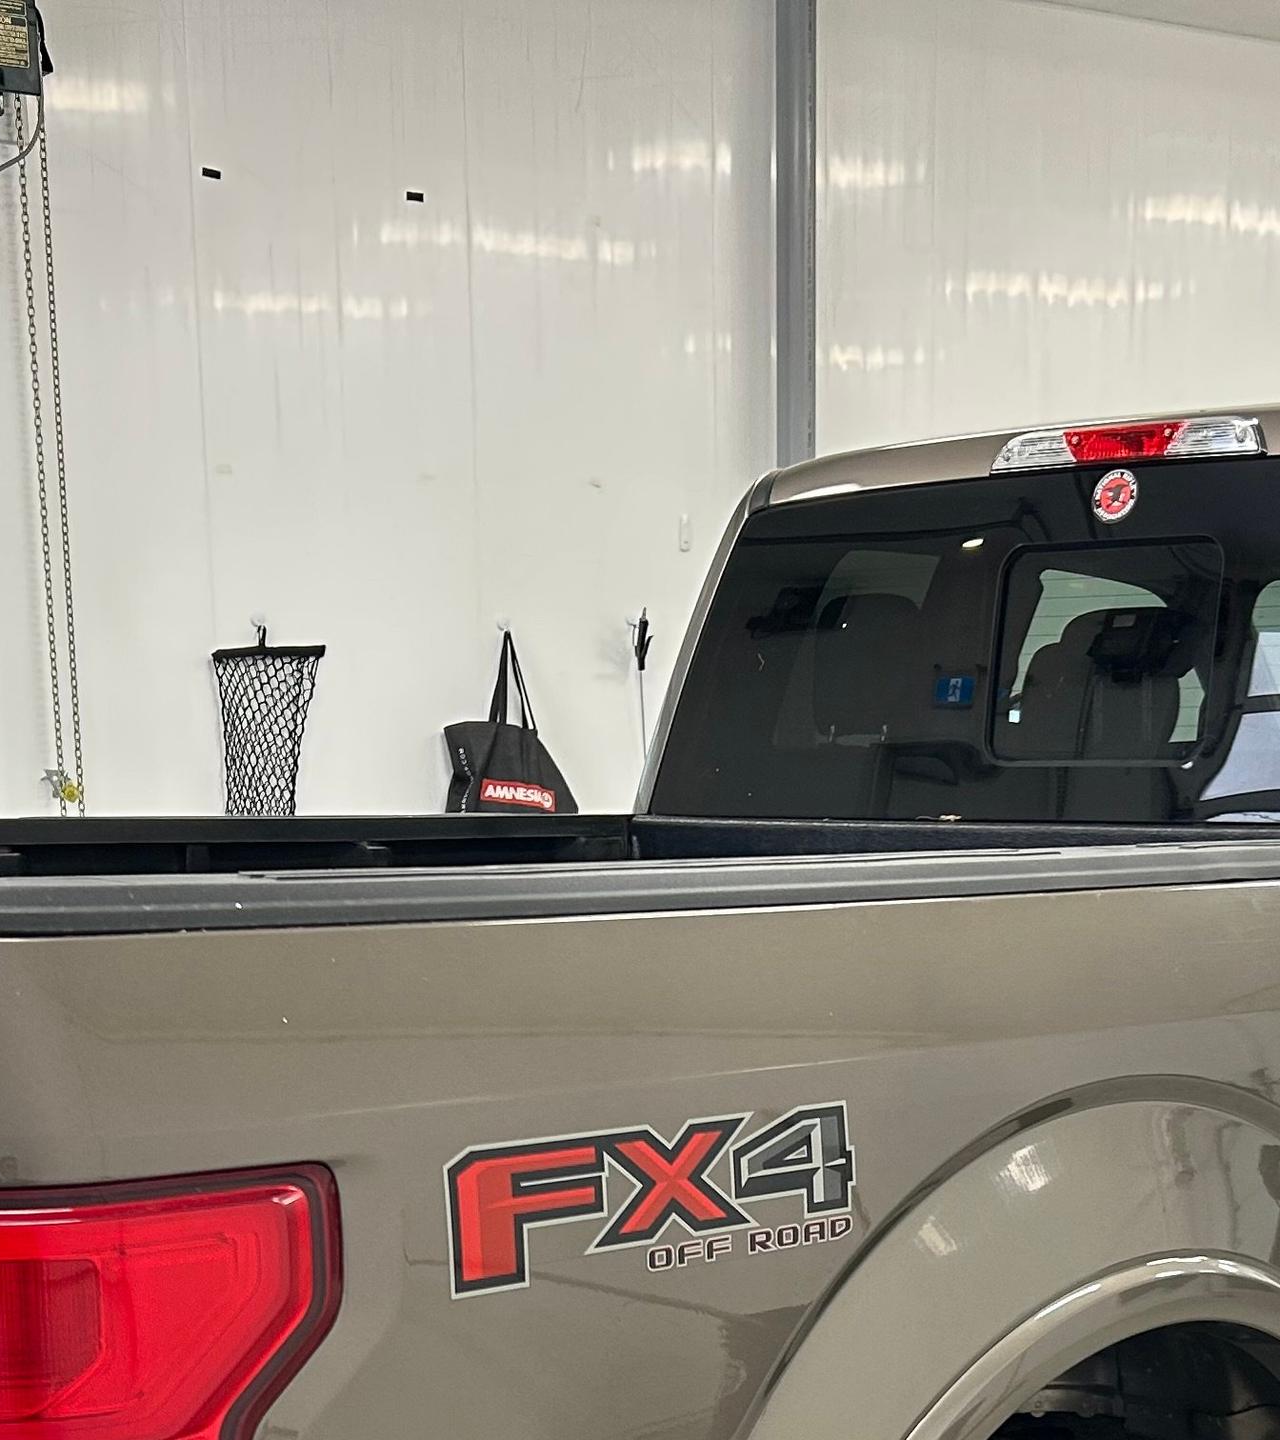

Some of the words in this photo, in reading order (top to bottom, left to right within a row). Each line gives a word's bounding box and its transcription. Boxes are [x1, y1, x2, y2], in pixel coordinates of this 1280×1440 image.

[443, 1100, 856, 1299] FX4
[646, 1235, 734, 1273] OFF
[747, 1216, 853, 1256] ROAD
